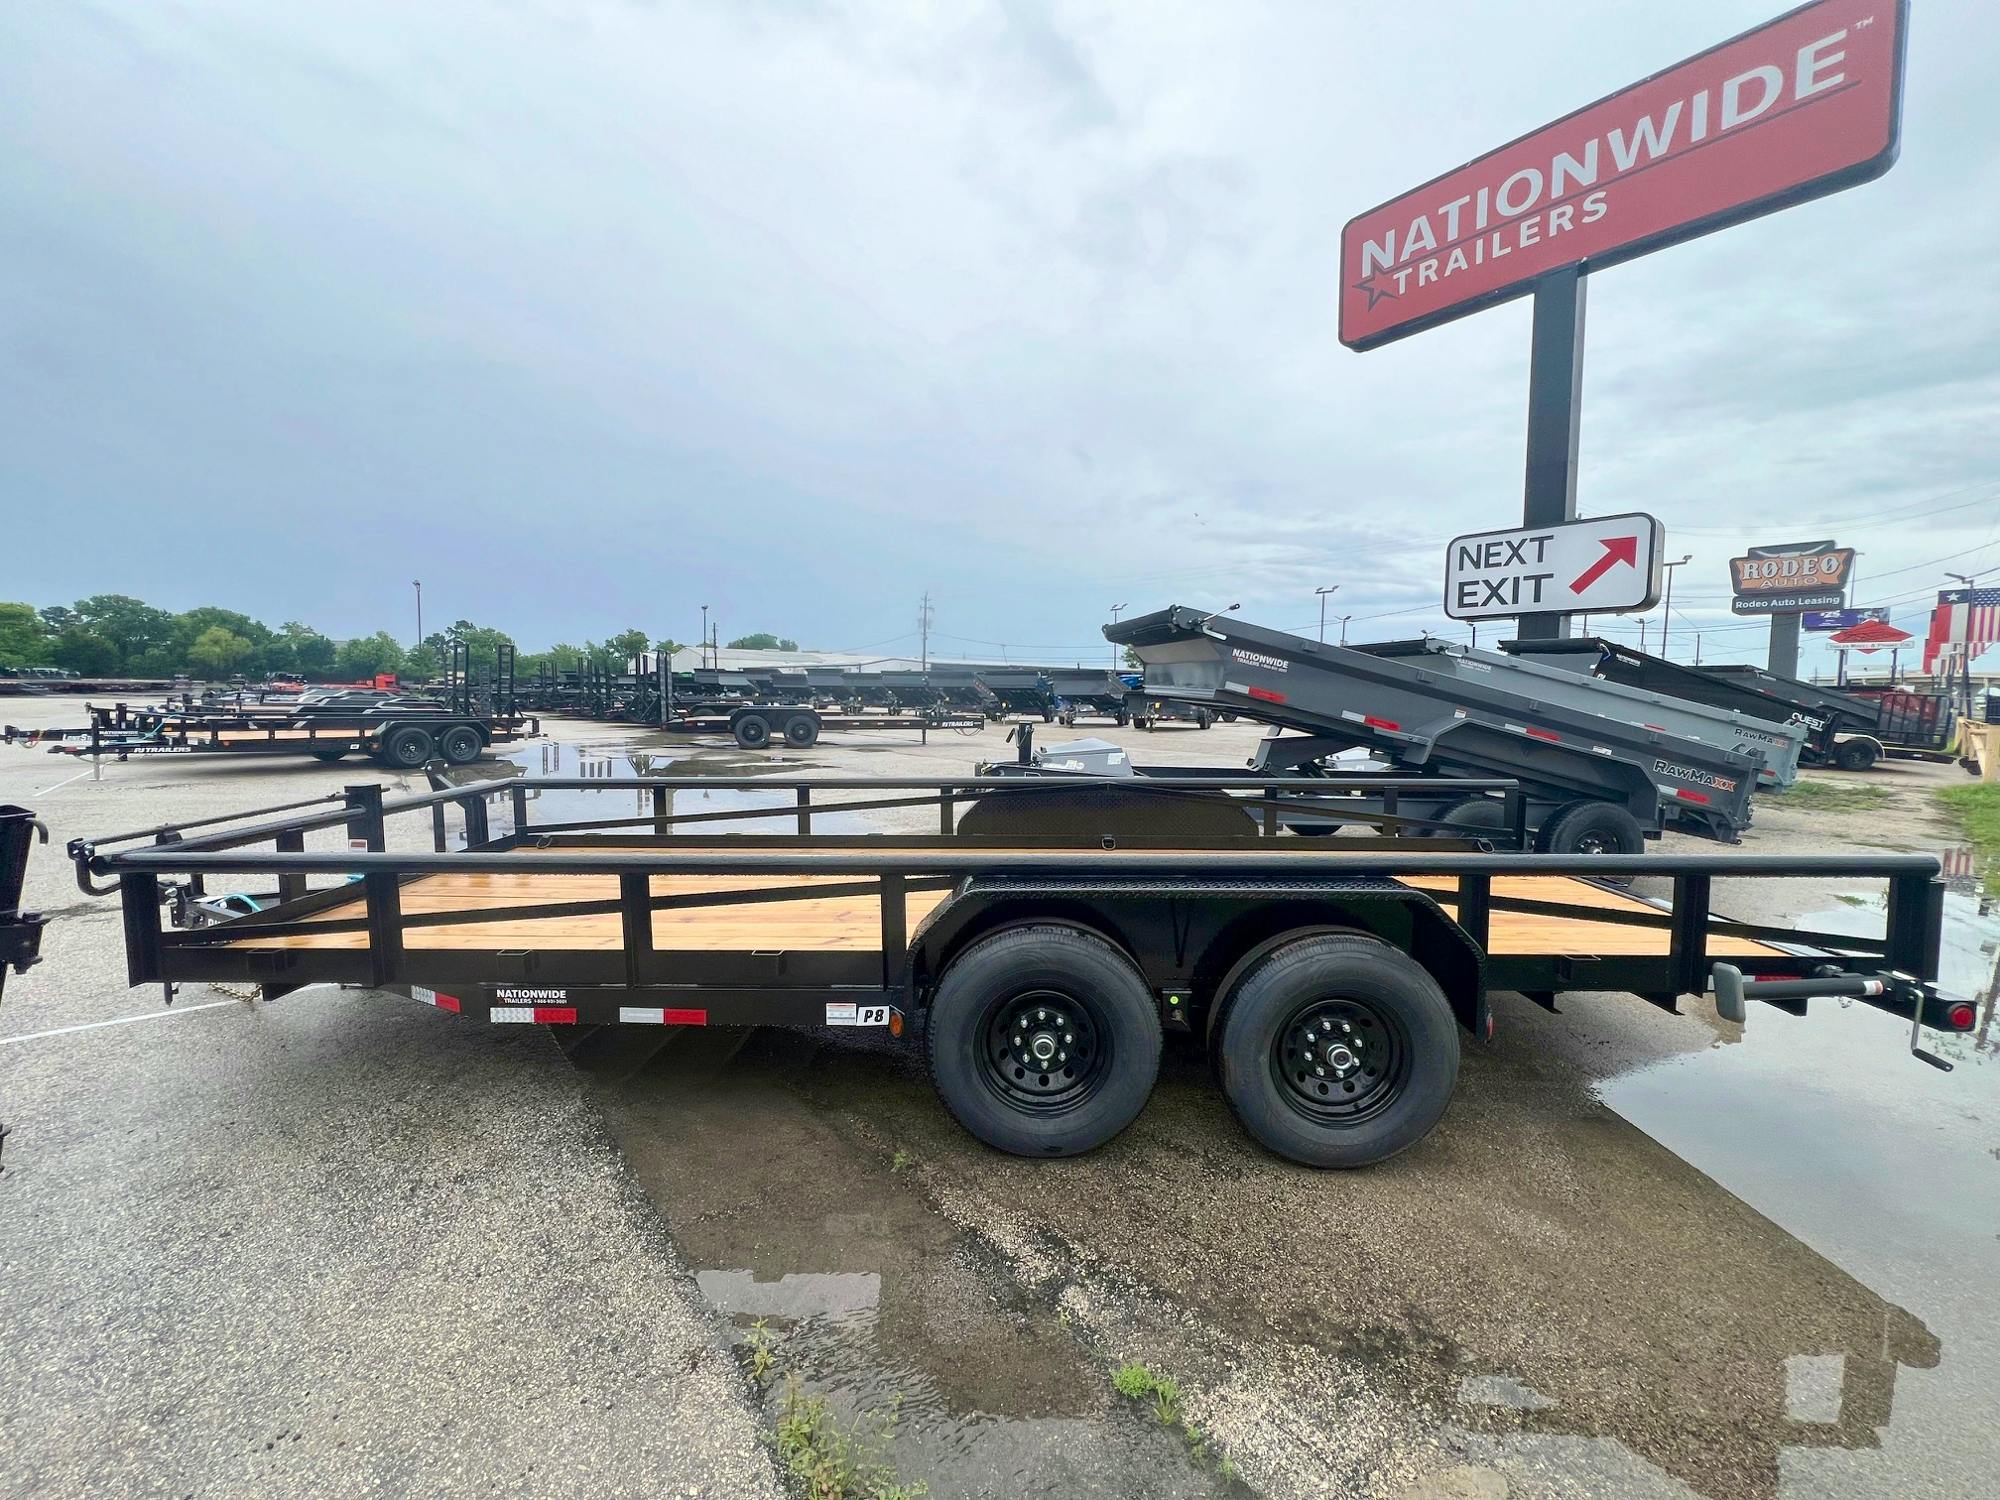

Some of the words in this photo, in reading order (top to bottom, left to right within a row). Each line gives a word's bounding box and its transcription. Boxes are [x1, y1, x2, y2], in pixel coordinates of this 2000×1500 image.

[1362, 29, 1848, 278] NATIONWIDE
[1393, 191, 1608, 296] TRAILERS
[1458, 535, 1554, 571] NEXT
[1742, 556, 1840, 580] RODEO
[1457, 573, 1554, 608] EXIT
[1760, 576, 1818, 588] AUTO
[1735, 600, 1768, 609] Rodeo
[1770, 598, 1796, 607] Auto
[1798, 596, 1841, 605] Leasing
[1232, 648, 1289, 669] NATIONWIDE
[496, 989, 567, 999] NATIONWIDE
[863, 1009, 885, 1023] P8
